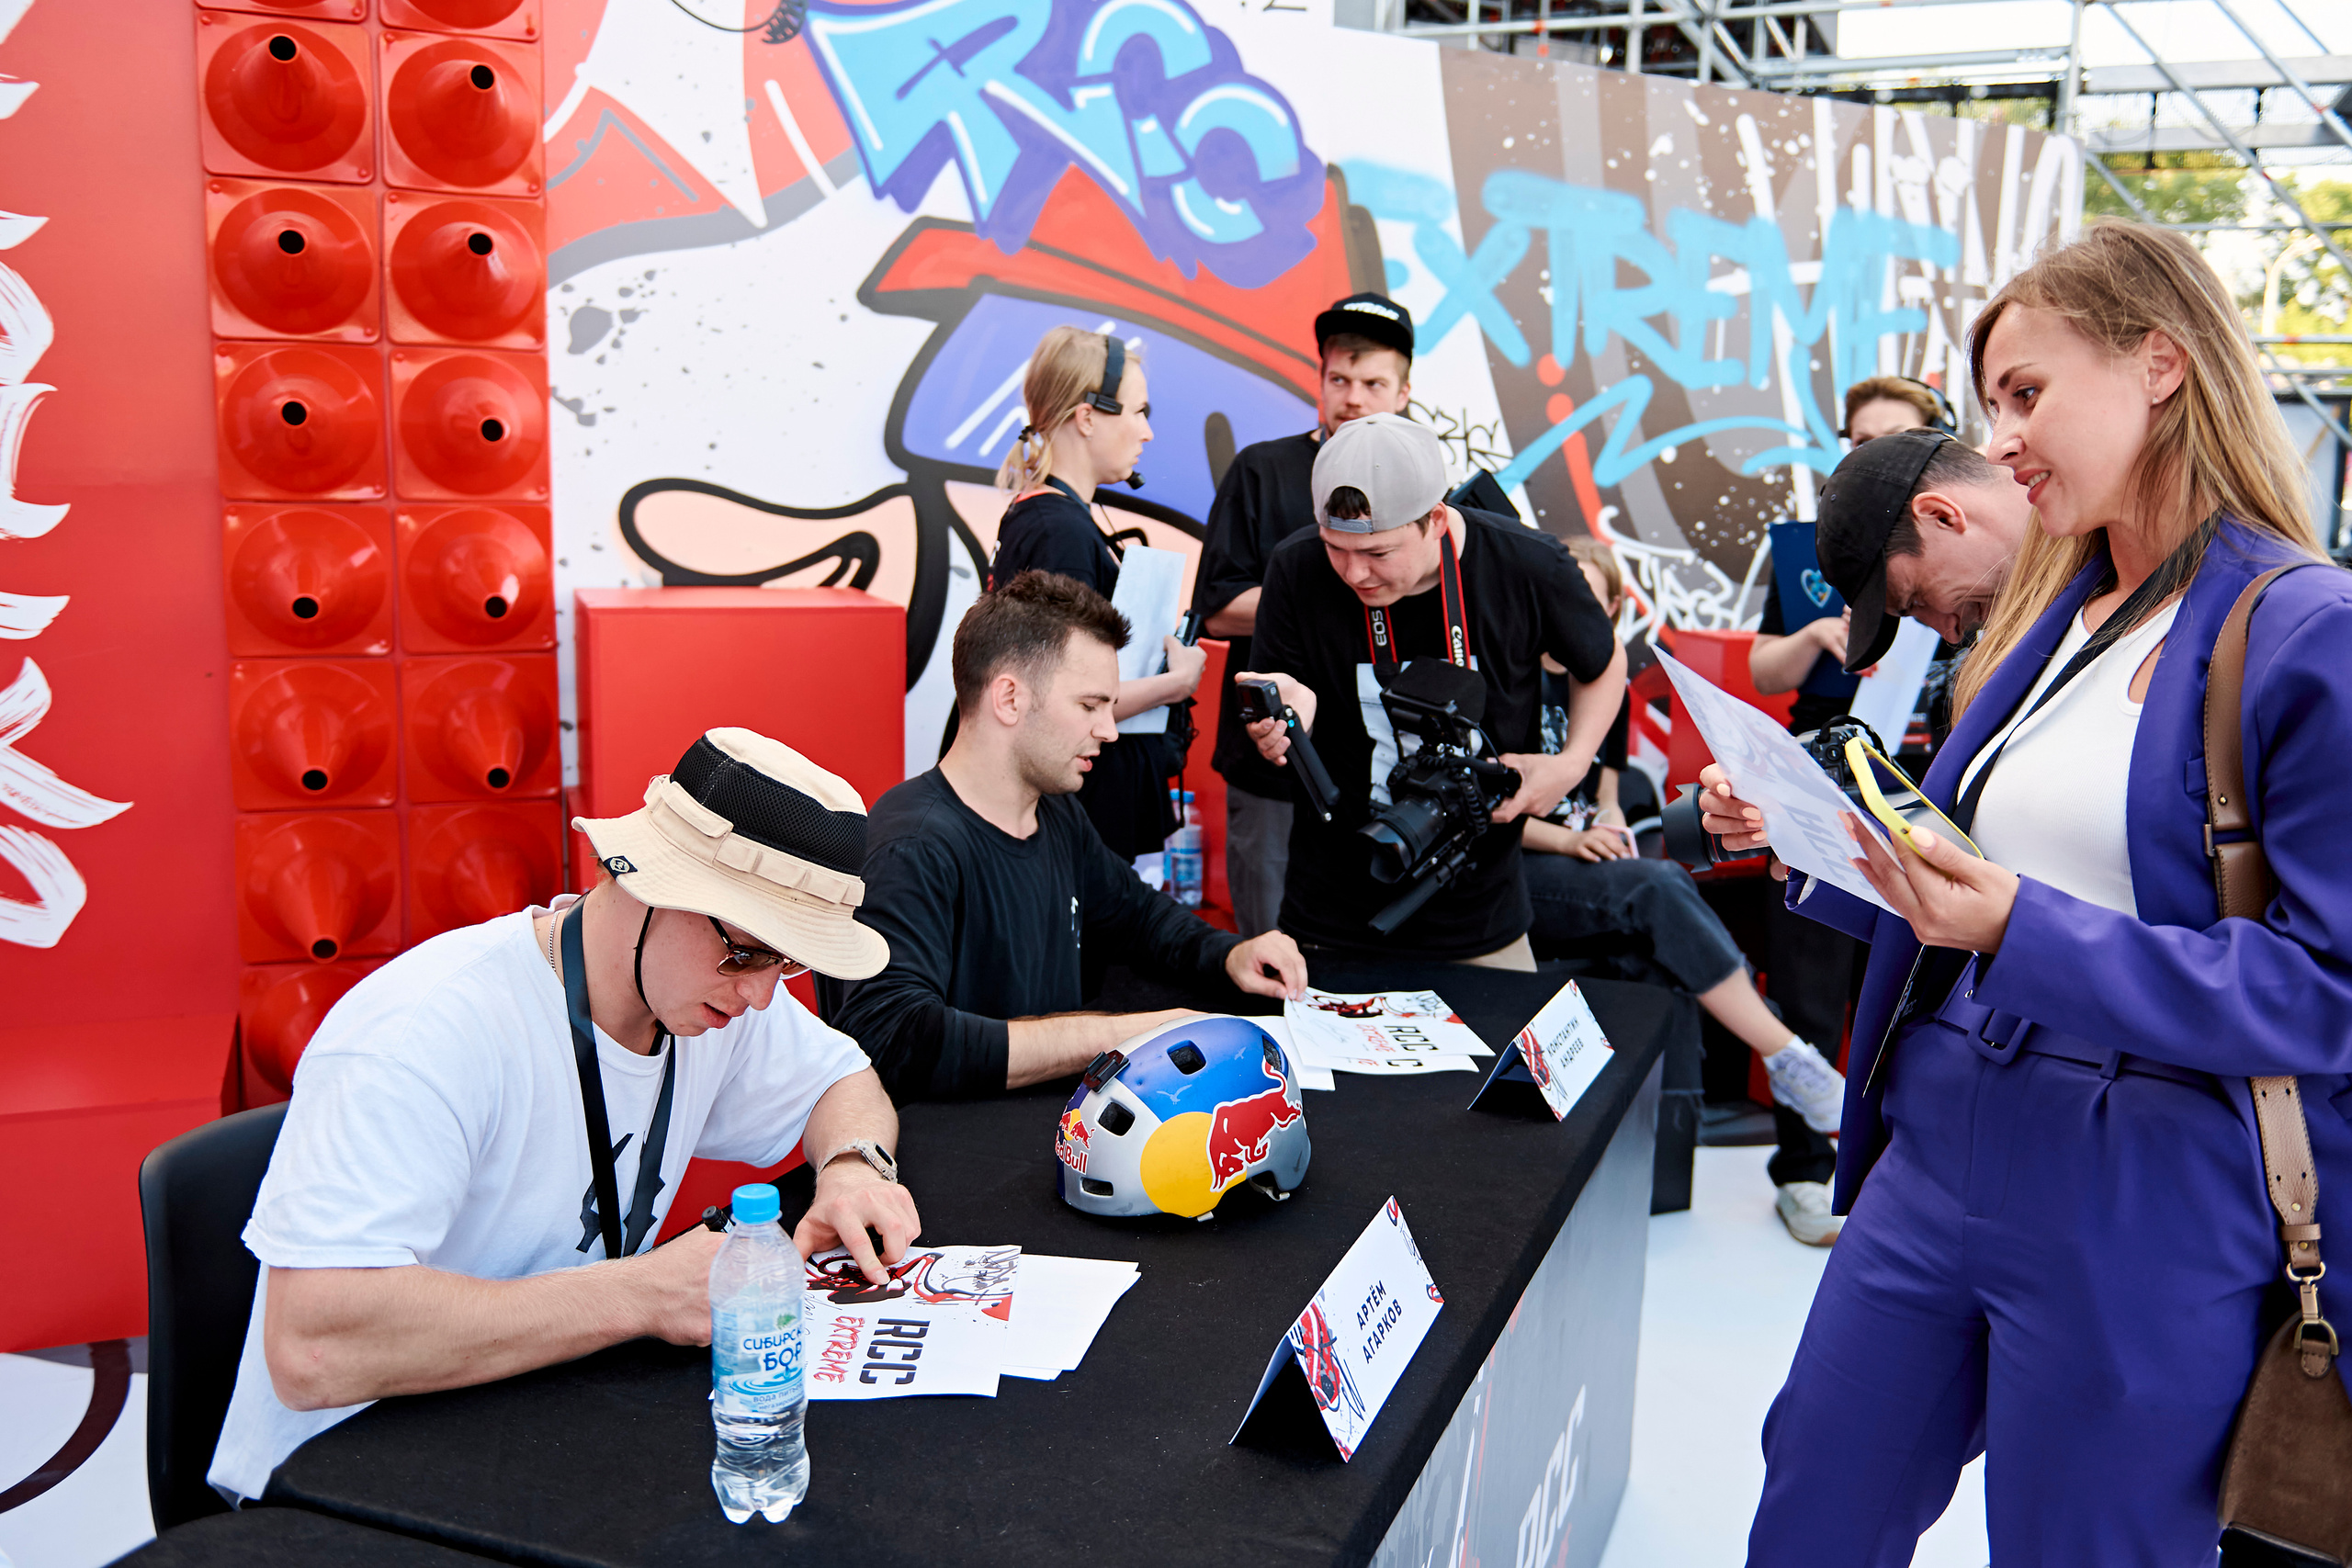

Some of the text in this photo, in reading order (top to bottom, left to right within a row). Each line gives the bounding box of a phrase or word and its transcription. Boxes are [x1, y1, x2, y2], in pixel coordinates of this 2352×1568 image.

[1371, 610, 1387, 647] EOS
[1451, 625, 1464, 667] Cano
[1384, 1025, 1439, 1051] RCC
[1545, 1016, 1580, 1057] КОНСТАНТИН
[1559, 1037, 1584, 1069] АНДРЕЕВ
[1065, 1144, 1088, 1174] Bull
[1356, 1280, 1386, 1330] АРТЁМ
[813, 1315, 865, 1383] EXTREME
[859, 1317, 931, 1385] RCC
[1363, 1299, 1402, 1364] АГАРКОВ
